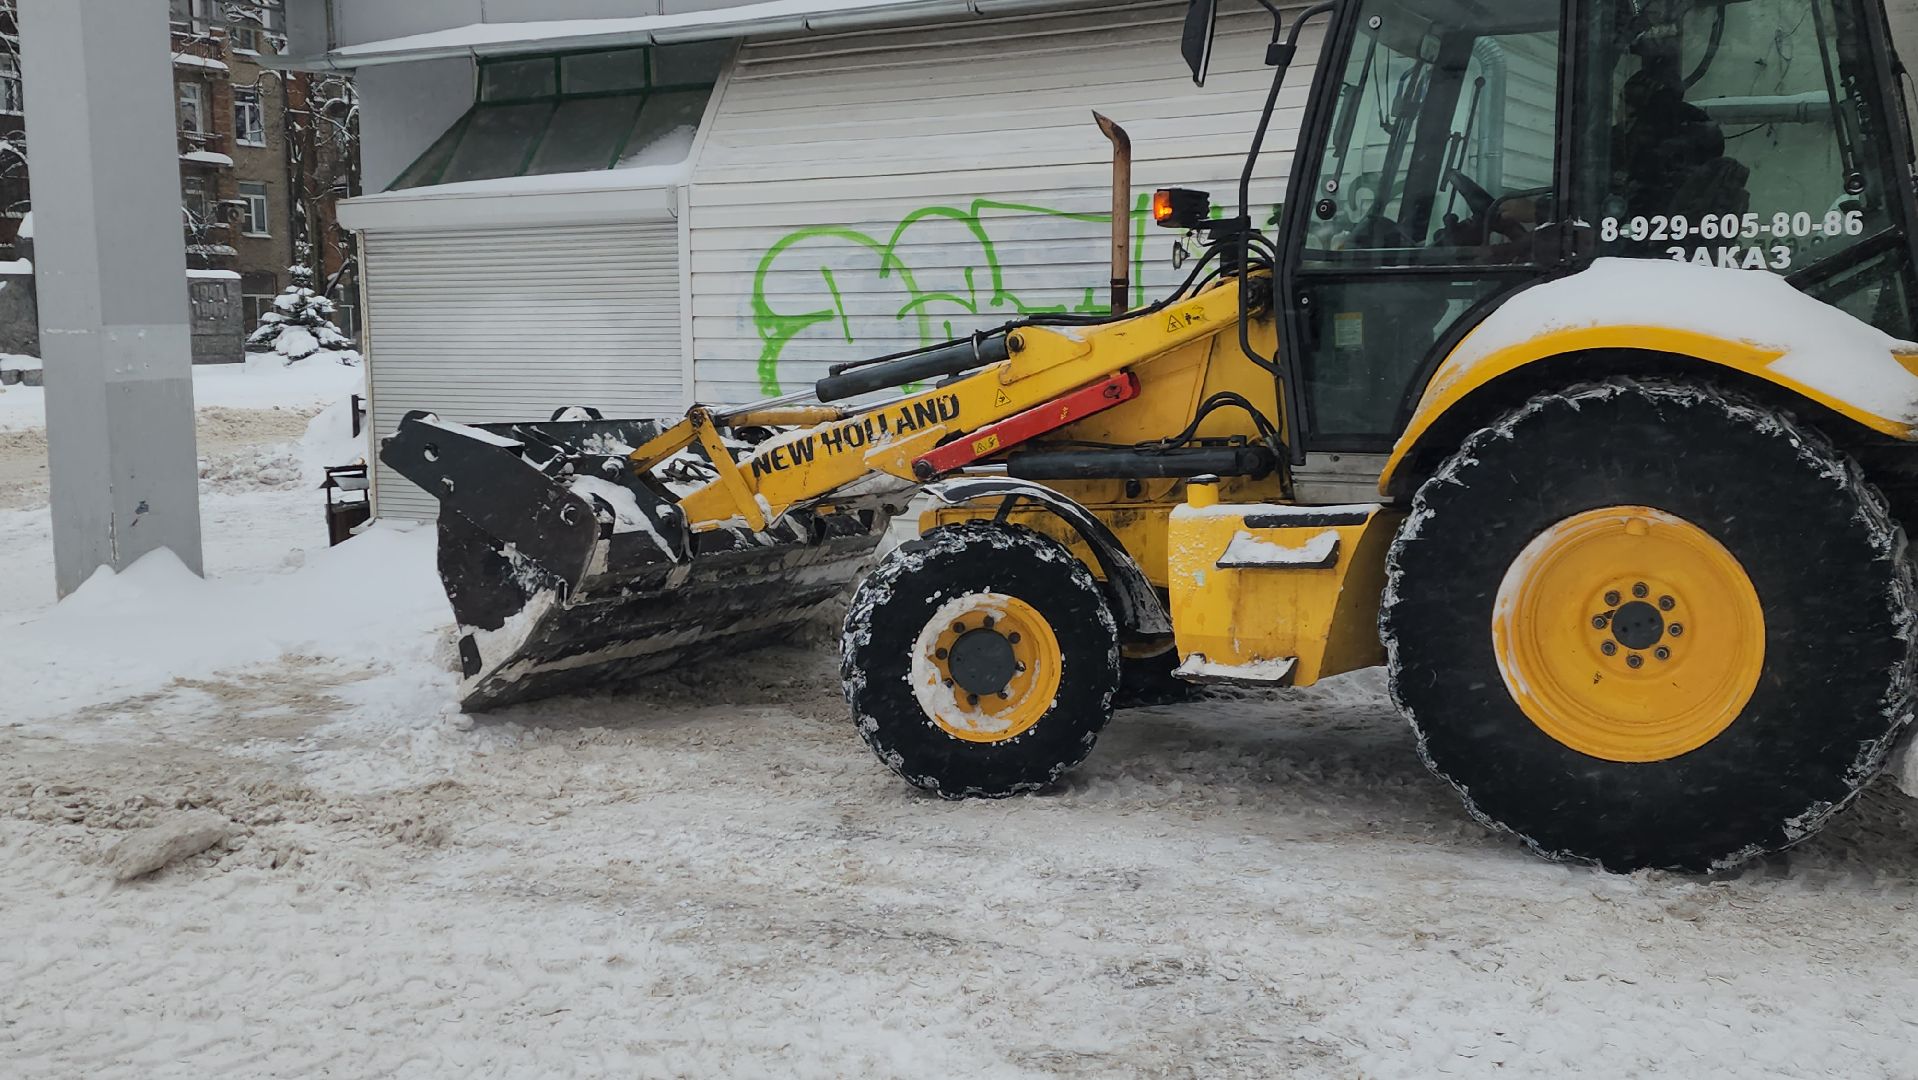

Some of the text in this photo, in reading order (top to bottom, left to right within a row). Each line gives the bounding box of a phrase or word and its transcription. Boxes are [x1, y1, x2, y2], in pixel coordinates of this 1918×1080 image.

[1600, 209, 1864, 241] 8-929-605-80-86
[751, 393, 960, 478] NEW HOLLAND
